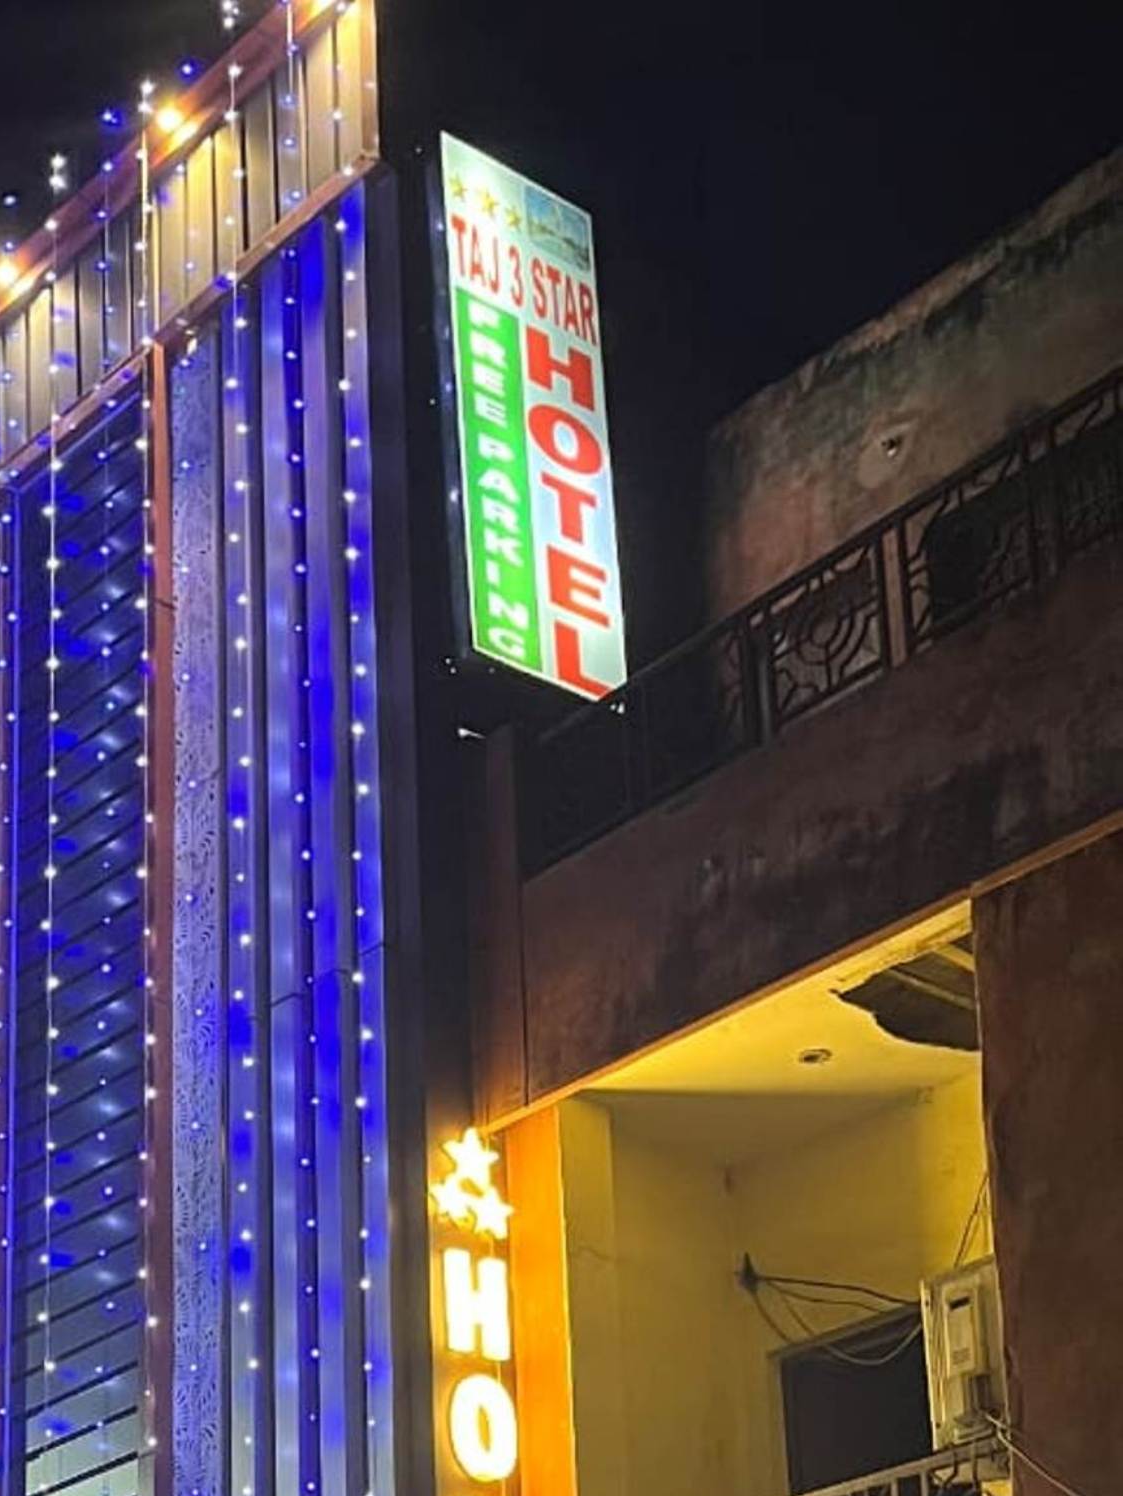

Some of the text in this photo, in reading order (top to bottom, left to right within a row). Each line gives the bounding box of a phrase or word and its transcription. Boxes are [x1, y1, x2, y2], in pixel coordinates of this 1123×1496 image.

[451, 214, 598, 347] TAJ 3 STAR
[468, 300, 530, 661] FREE PARKING
[526, 324, 616, 700] HOTEL
